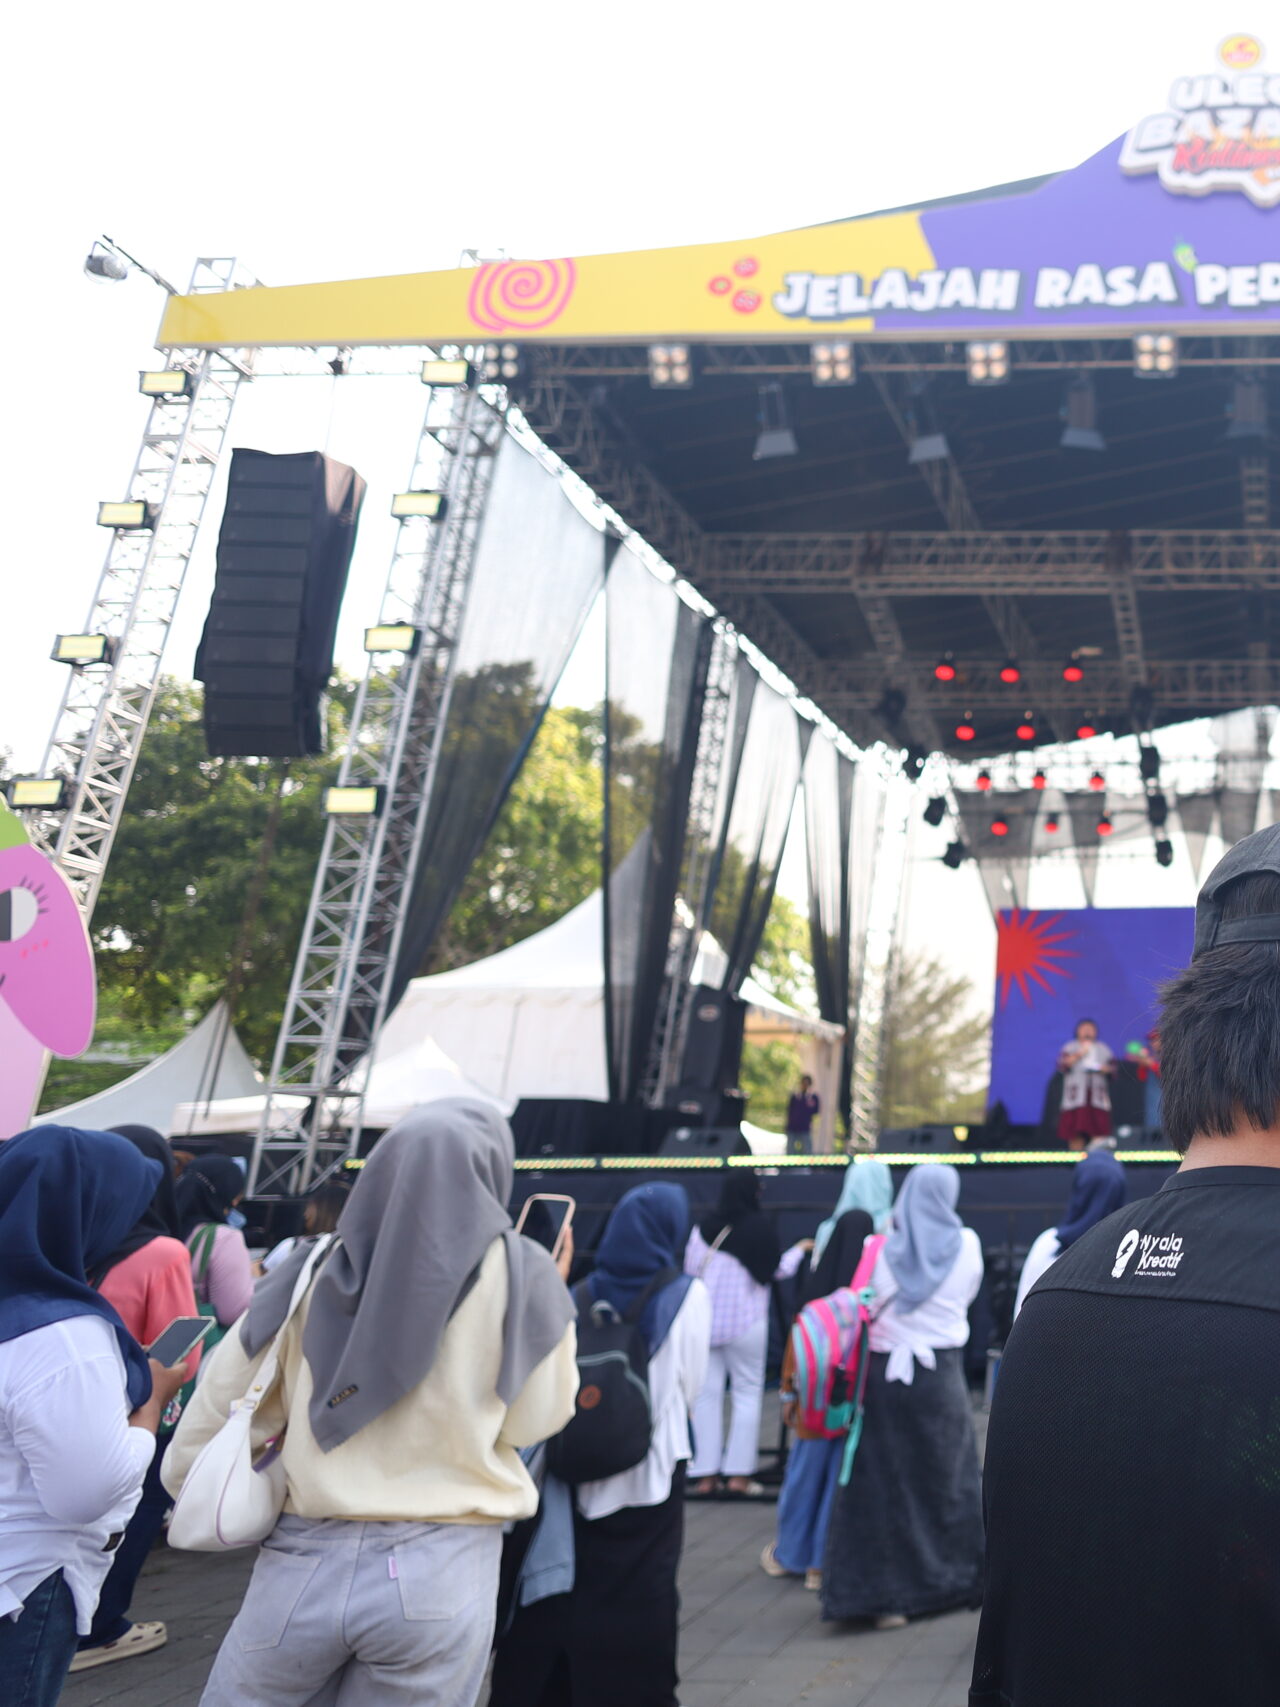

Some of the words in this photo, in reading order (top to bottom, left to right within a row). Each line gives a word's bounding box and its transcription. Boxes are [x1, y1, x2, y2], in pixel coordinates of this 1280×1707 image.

[774, 266, 1021, 317] JELAJAH
[1034, 261, 1178, 309] RASA
[1140, 1233, 1183, 1252] Nyala
[1137, 1252, 1184, 1269] Kreatif
